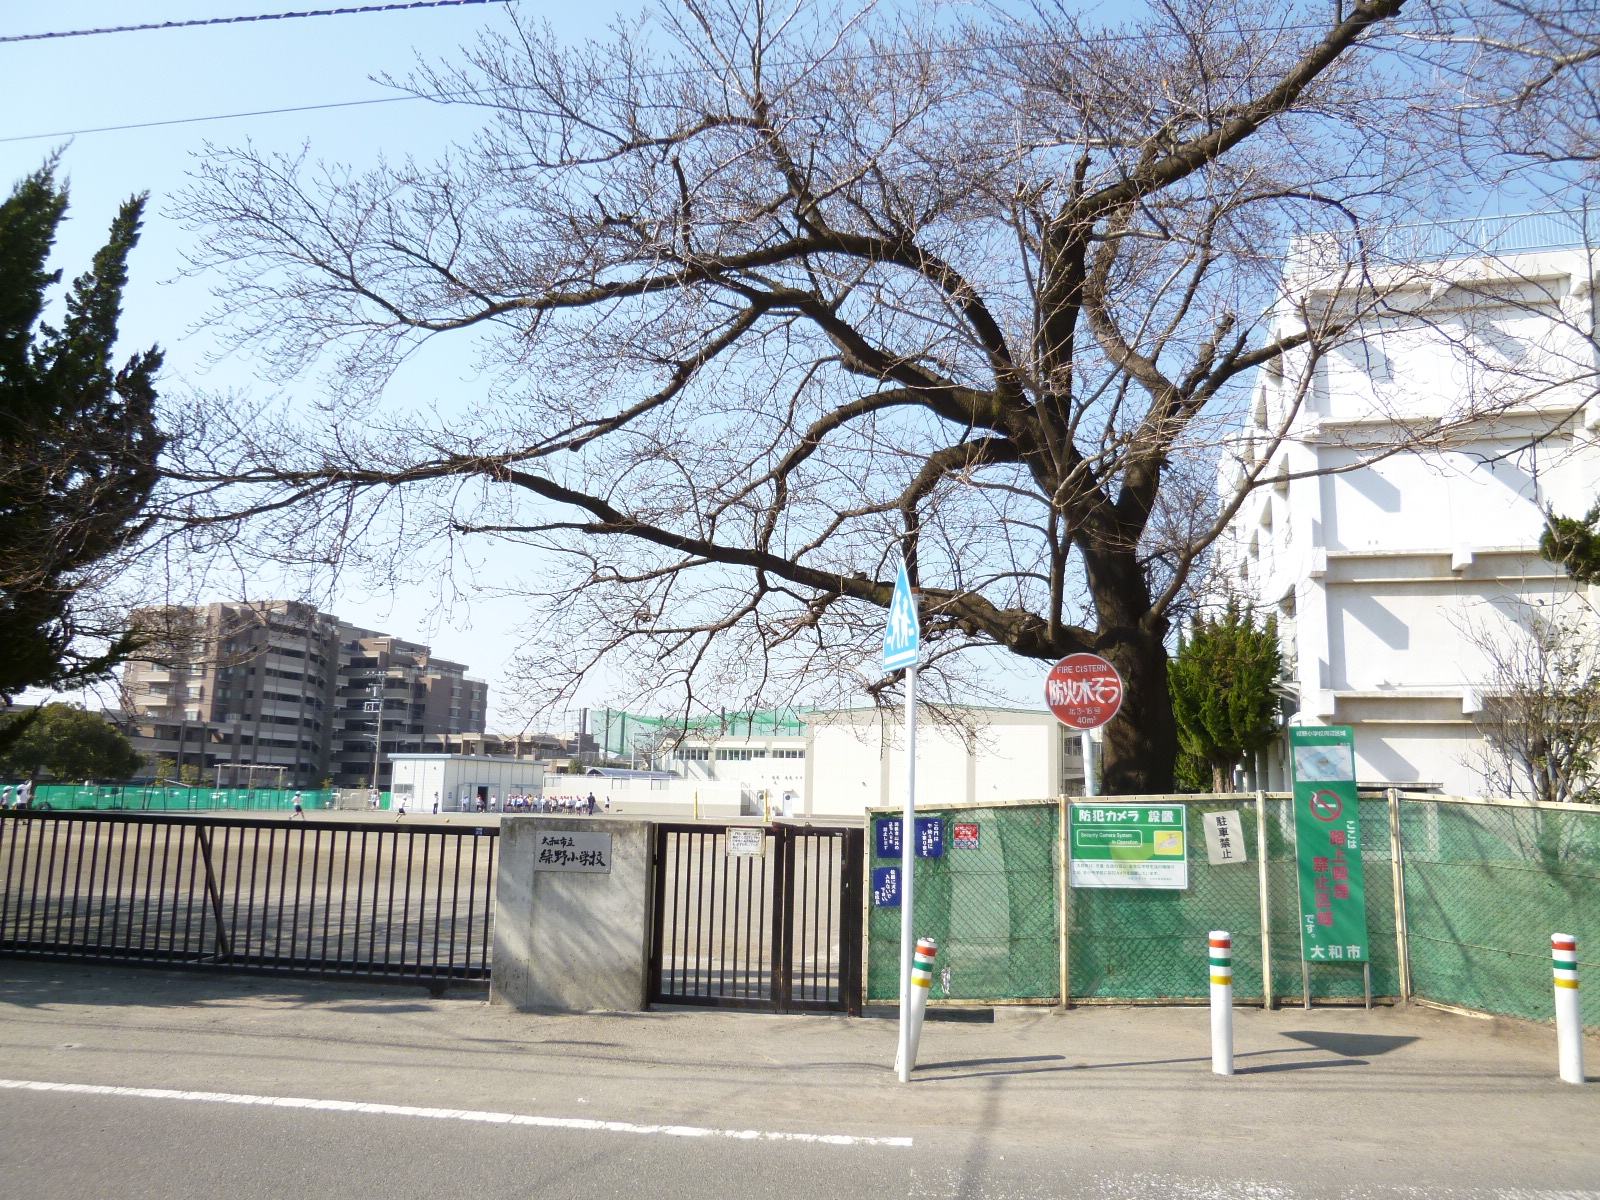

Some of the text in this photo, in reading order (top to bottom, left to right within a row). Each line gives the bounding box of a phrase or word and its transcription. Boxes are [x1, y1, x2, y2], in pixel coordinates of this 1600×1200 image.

[1057, 664, 1107, 674] FIRE CISTERN
[1048, 677, 1119, 706] 防火水そう
[1079, 810, 1175, 823] 防犯カメラ 設置
[541, 836, 575, 848] 大和市立
[1216, 816, 1233, 859] 駐車禁止
[538, 849, 606, 866] 緑野小学校
[1329, 830, 1350, 899] 路上喫煙
[1313, 856, 1334, 927] 禁止区域
[1304, 914, 1316, 939] です。
[1310, 945, 1361, 959] 大和市
